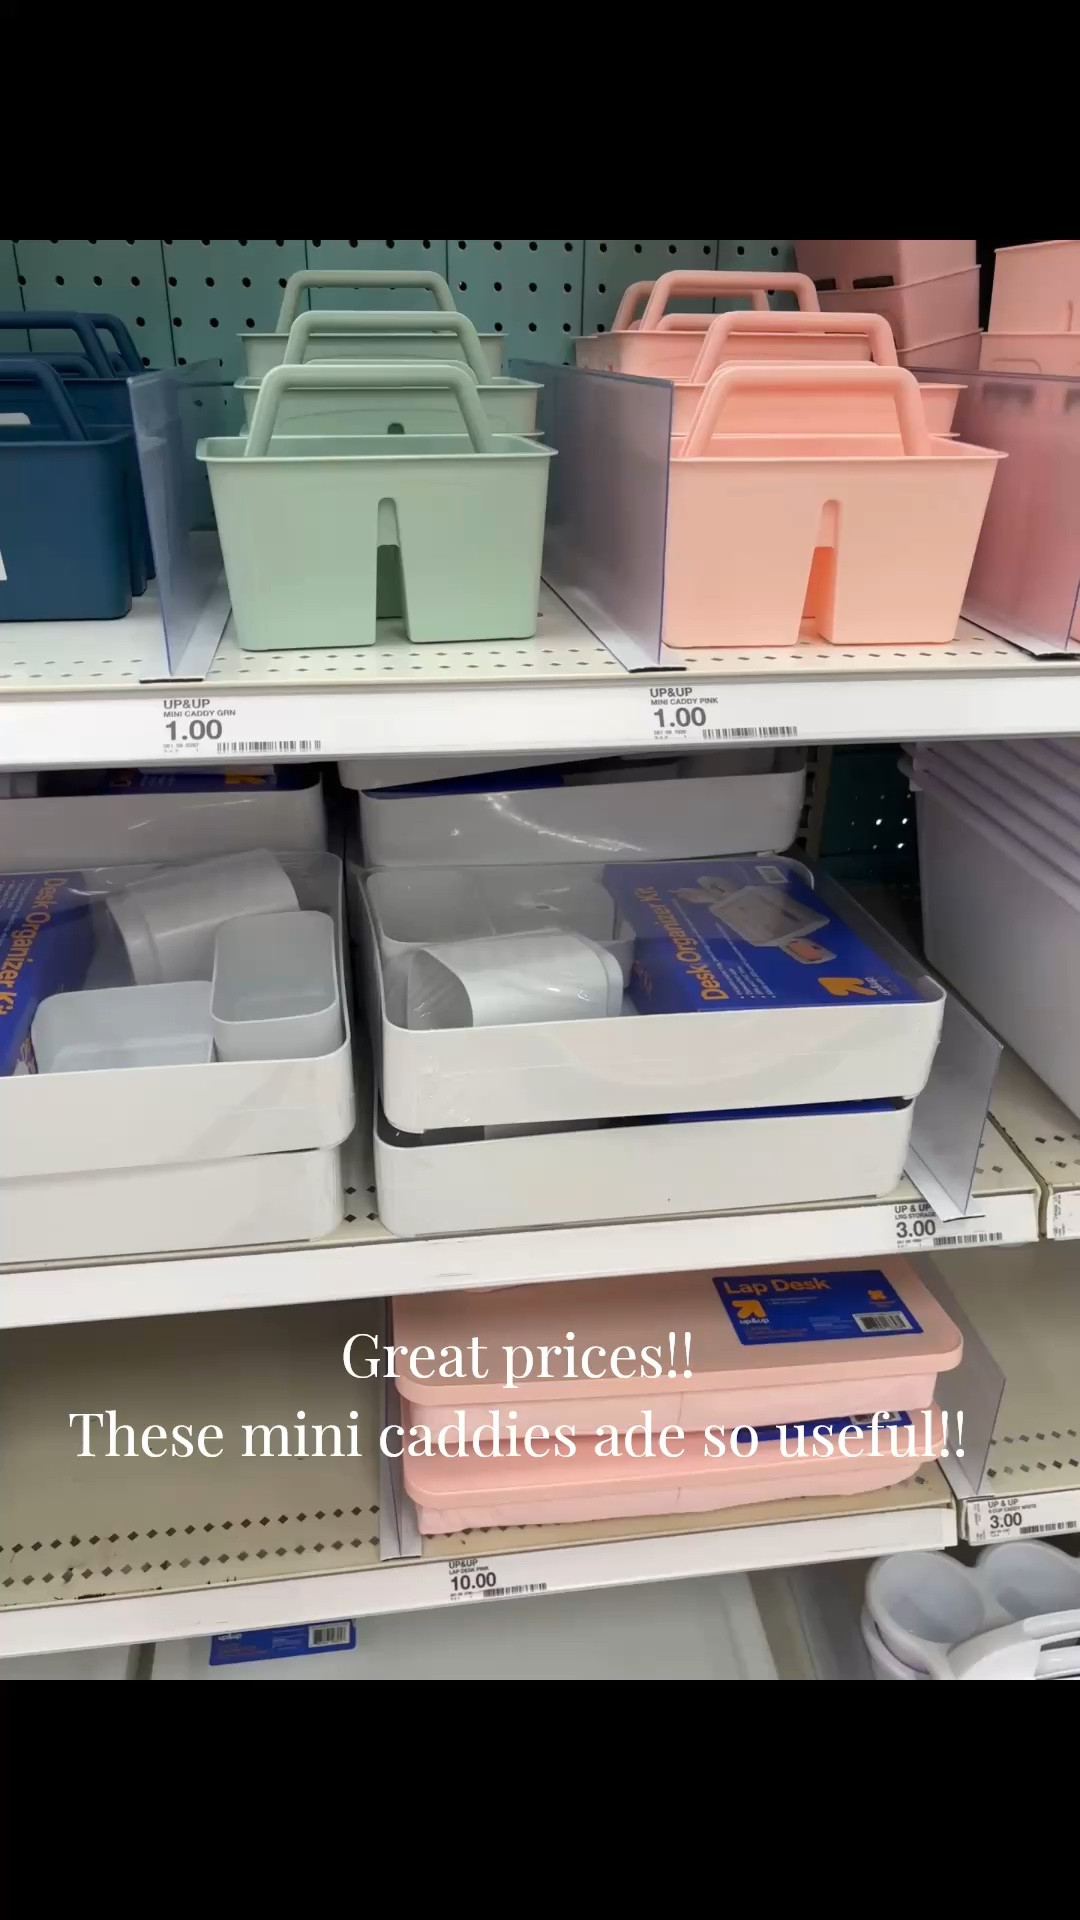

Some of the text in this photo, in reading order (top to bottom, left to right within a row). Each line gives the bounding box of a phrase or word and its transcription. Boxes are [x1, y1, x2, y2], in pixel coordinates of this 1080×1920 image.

[649, 687, 693, 698] UP&UP
[163, 699, 210, 709] UP&UP
[216, 709, 236, 717] GRN
[653, 706, 707, 728] 1.00
[165, 719, 223, 741] 1.00
[31, 877, 70, 908] Desk
[649, 903, 702, 965] Organizer
[0, 910, 52, 989] Organizer
[686, 961, 730, 1001] Desk
[894, 1203, 932, 1214] UP & UP
[896, 1219, 937, 1238] 3.00
[723, 1277, 831, 1297] Lap Desk
[988, 1498, 1019, 1508] UP & UP
[989, 1512, 1022, 1529] 3.00
[448, 1558, 478, 1569] UP&UP
[450, 1571, 497, 1592] 10.00
